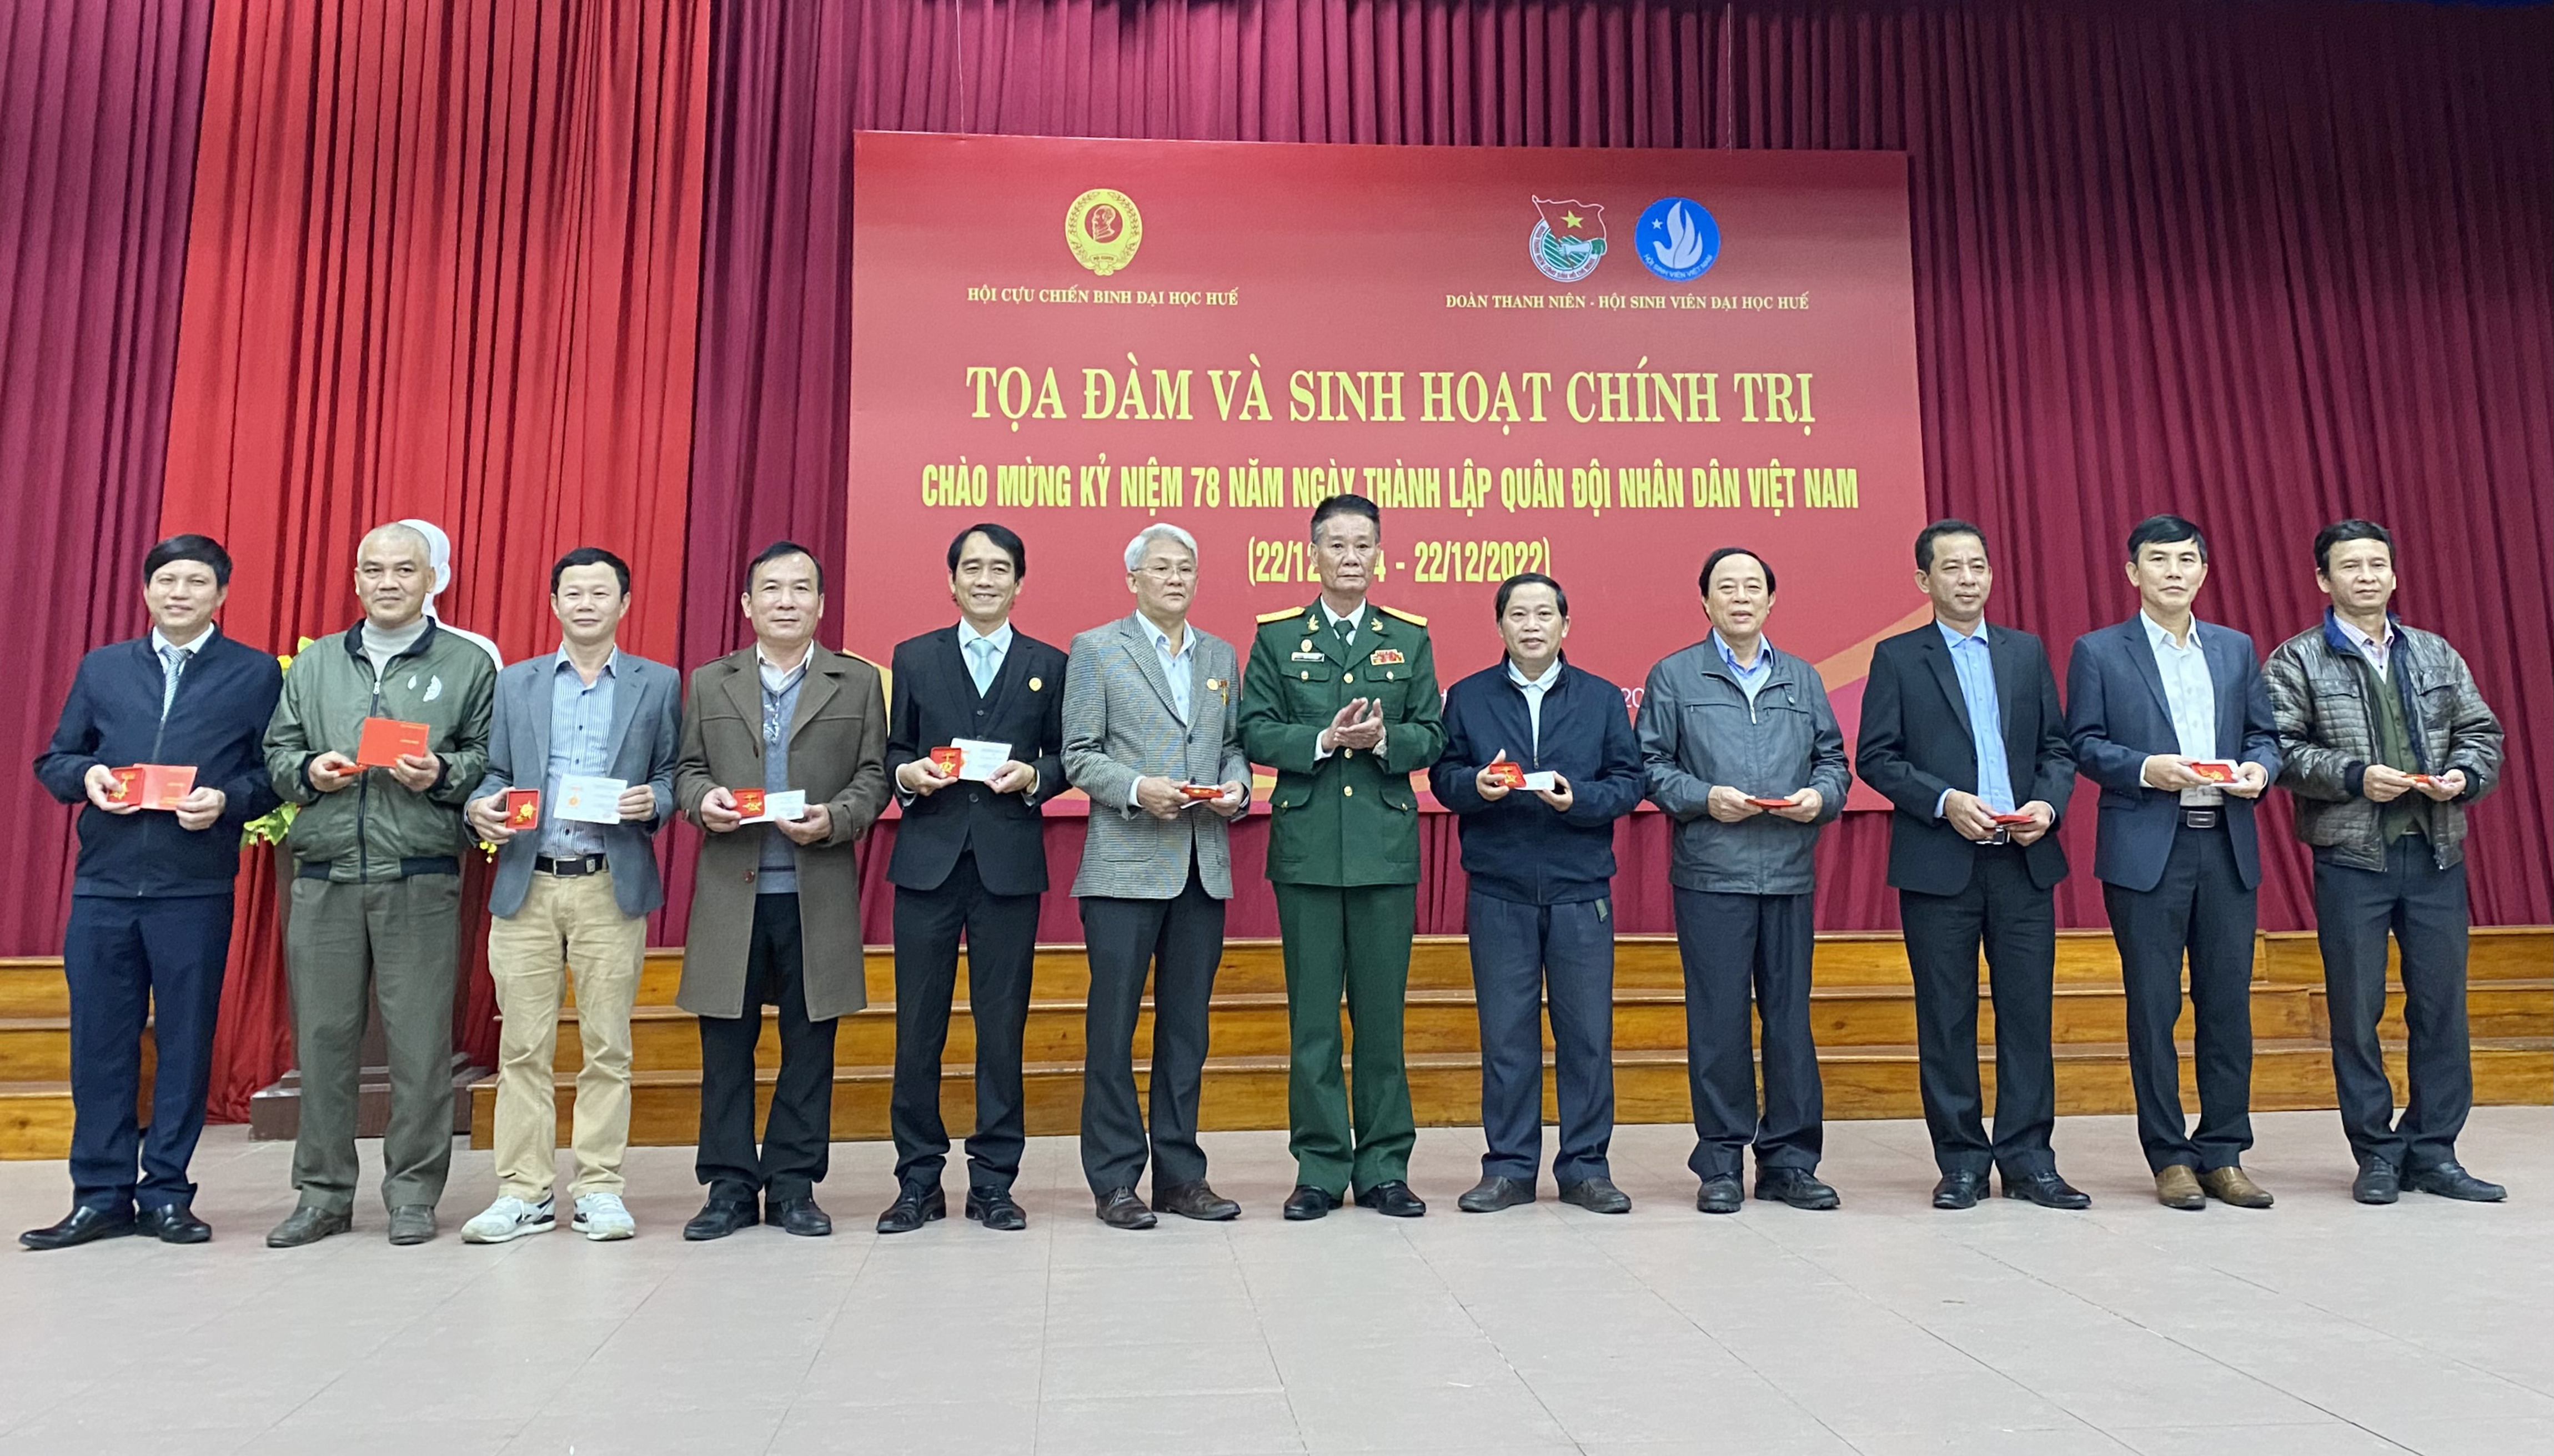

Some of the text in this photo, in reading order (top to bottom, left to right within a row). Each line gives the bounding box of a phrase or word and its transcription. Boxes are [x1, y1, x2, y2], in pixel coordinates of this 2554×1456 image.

[967, 284, 1239, 308] HỘI CỰU CHIẾN BINH ĐẠI HỌC HUẾ
[1446, 292, 1488, 308] ĐOÀN
[1492, 295, 1544, 308] THANH
[1548, 292, 1585, 308] NIÊN
[1598, 292, 1626, 312] HỘI
[1630, 295, 1666, 309] SINH
[1669, 293, 1707, 309] VIÊN
[1710, 296, 1737, 312] ĐẠI
[1742, 296, 1773, 312] HỌC
[1778, 291, 1809, 309] HUẾ
[966, 352, 1816, 436] TỌA ĐÀM VÀ SINH HOẠT CHÍNH TRỊ
[922, 453, 1859, 518] CHÀO MỪNG KỶ NIỆM 78 NĂM NGÀY THÀNH LẬP QUÂN ĐỘI NHÂN DÂN VIỆT NAM
[1396, 561, 1405, 570] -
[1414, 536, 1551, 583] 22/12/2022)
